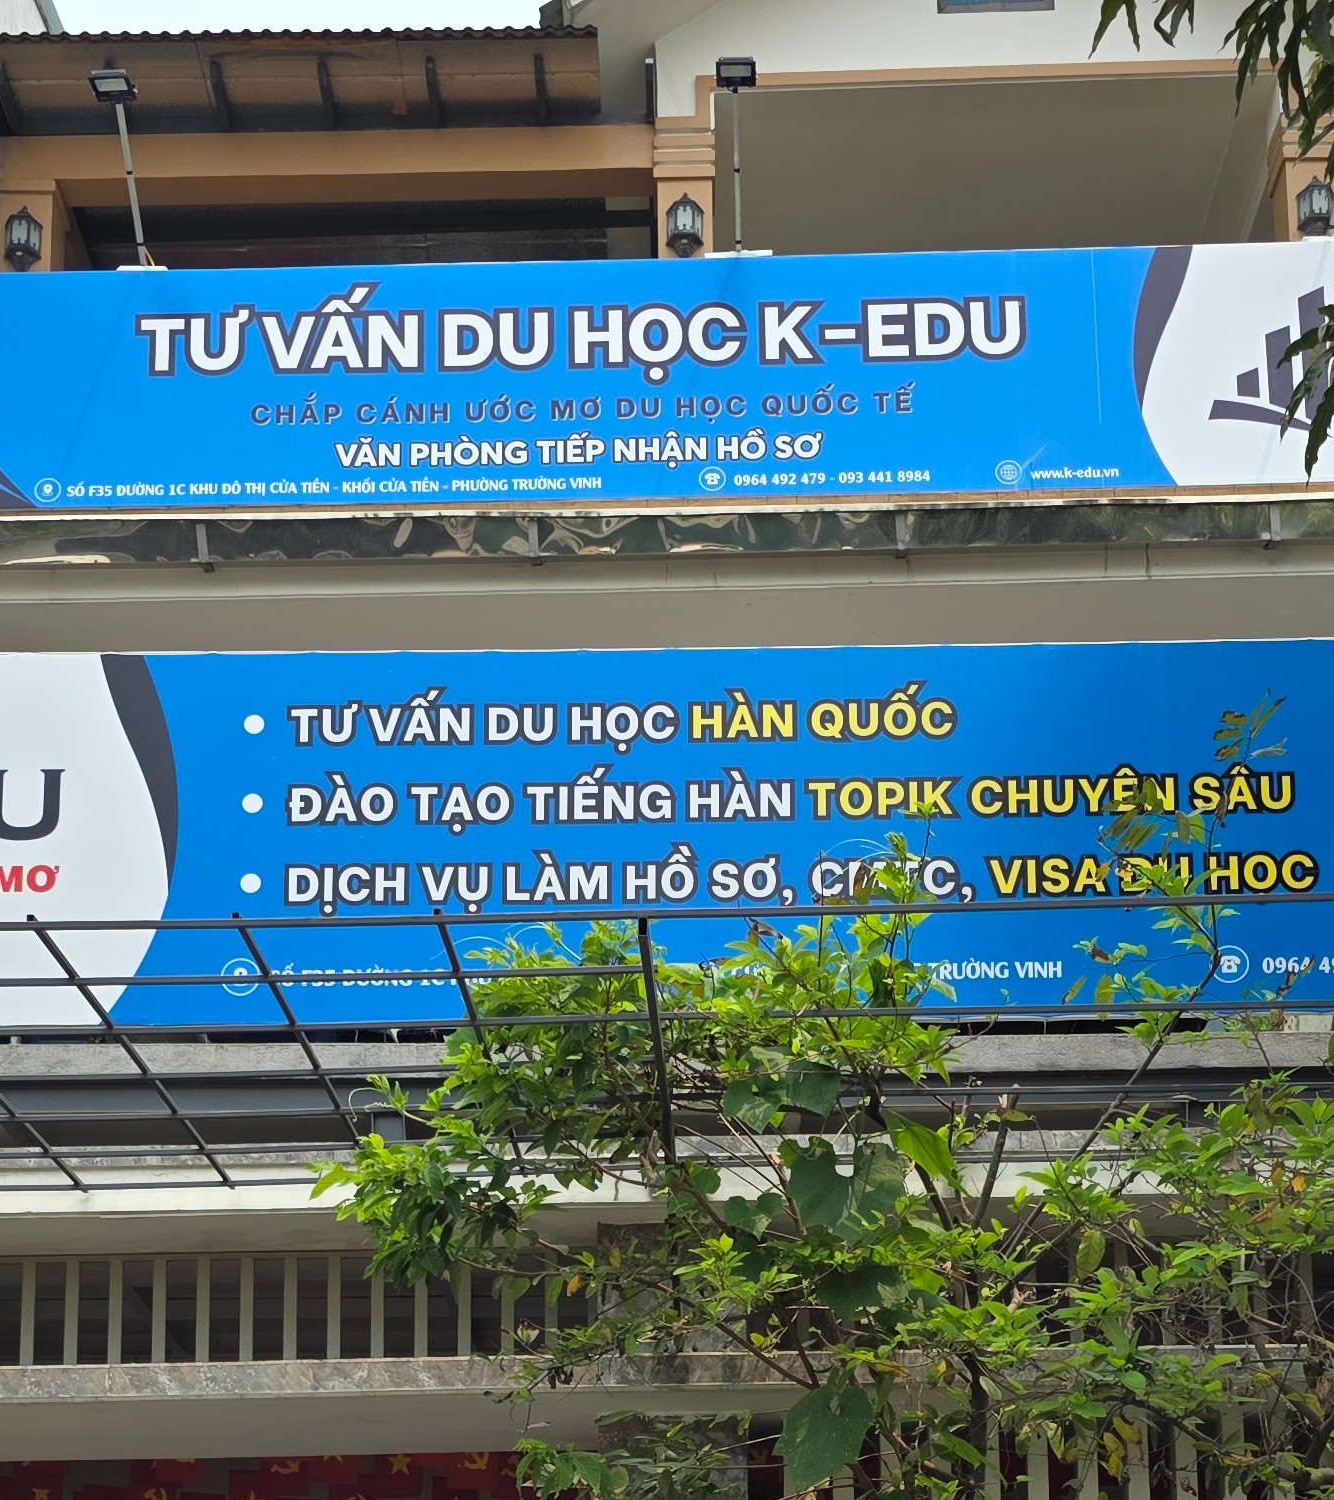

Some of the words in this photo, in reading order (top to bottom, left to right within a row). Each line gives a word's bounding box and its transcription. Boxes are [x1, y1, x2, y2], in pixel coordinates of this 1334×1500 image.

[136, 305, 254, 374] TƯ
[259, 284, 421, 372] VẤN
[441, 308, 551, 369] DU
[571, 304, 744, 383] HỌC
[761, 298, 1025, 361] K-EDU
[250, 391, 343, 425] CHẮP
[355, 395, 451, 424] CÁNH
[464, 393, 537, 423] ƯỚC
[550, 396, 602, 421] MƠ
[615, 396, 662, 419] DU
[675, 395, 748, 424] HỌC
[760, 382, 859, 417] QUỐC
[872, 380, 915, 414] TẾ
[335, 436, 402, 467] VĂN
[410, 434, 529, 466] PHÒNG
[535, 427, 606, 464] TIẾP
[613, 430, 708, 469] NHẬN
[717, 428, 766, 461] HỒ
[773, 432, 824, 460] SƠ
[66, 481, 85, 497] SỐ
[88, 485, 113, 497] F35
[117, 482, 165, 497] ĐƯỜNG
[169, 484, 186, 496] 1C
[190, 482, 219, 495] KHU
[222, 480, 241, 495] ĐÔ
[245, 481, 266, 497] THỊ
[269, 478, 298, 494] CỬA
[342, 477, 376, 493] KHỐI
[378, 477, 408, 493] CỬA
[451, 477, 509, 492] PHƯỜNG
[512, 476, 567, 491] TRƯỜNG
[570, 476, 602, 490] VINH
[733, 474, 768, 486] 0964
[771, 473, 797, 485] 492
[800, 472, 826, 484] 479
[838, 472, 864, 484] 093
[868, 471, 893, 483] 441
[897, 470, 931, 482] 8984
[1030, 466, 1120, 480] www.k-edu.vn
[289, 702, 360, 743] TƯ
[368, 690, 471, 743] VẤN
[487, 706, 555, 742] DU
[570, 704, 675, 752] HỌC
[691, 692, 794, 739] HÀN
[810, 684, 954, 739] QUỐC
[288, 774, 395, 823] ĐÀO
[410, 785, 511, 833] TẠO
[526, 766, 672, 822] TIẾNG
[688, 770, 791, 818] HÀN
[808, 780, 954, 817] TOPIK
[1192, 764, 1293, 811] SÂU
[287, 865, 407, 914] DỊCH
[421, 865, 490, 913] VỤ
[505, 852, 609, 901] LÀM
[625, 845, 695, 901] HỒ
[711, 857, 794, 906] SƠ,
[989, 859, 1105, 894] VISA
[927, 957, 1009, 980] TRƯỜNG
[1014, 960, 1063, 978] VINH
[1262, 955, 1314, 974] 0964
